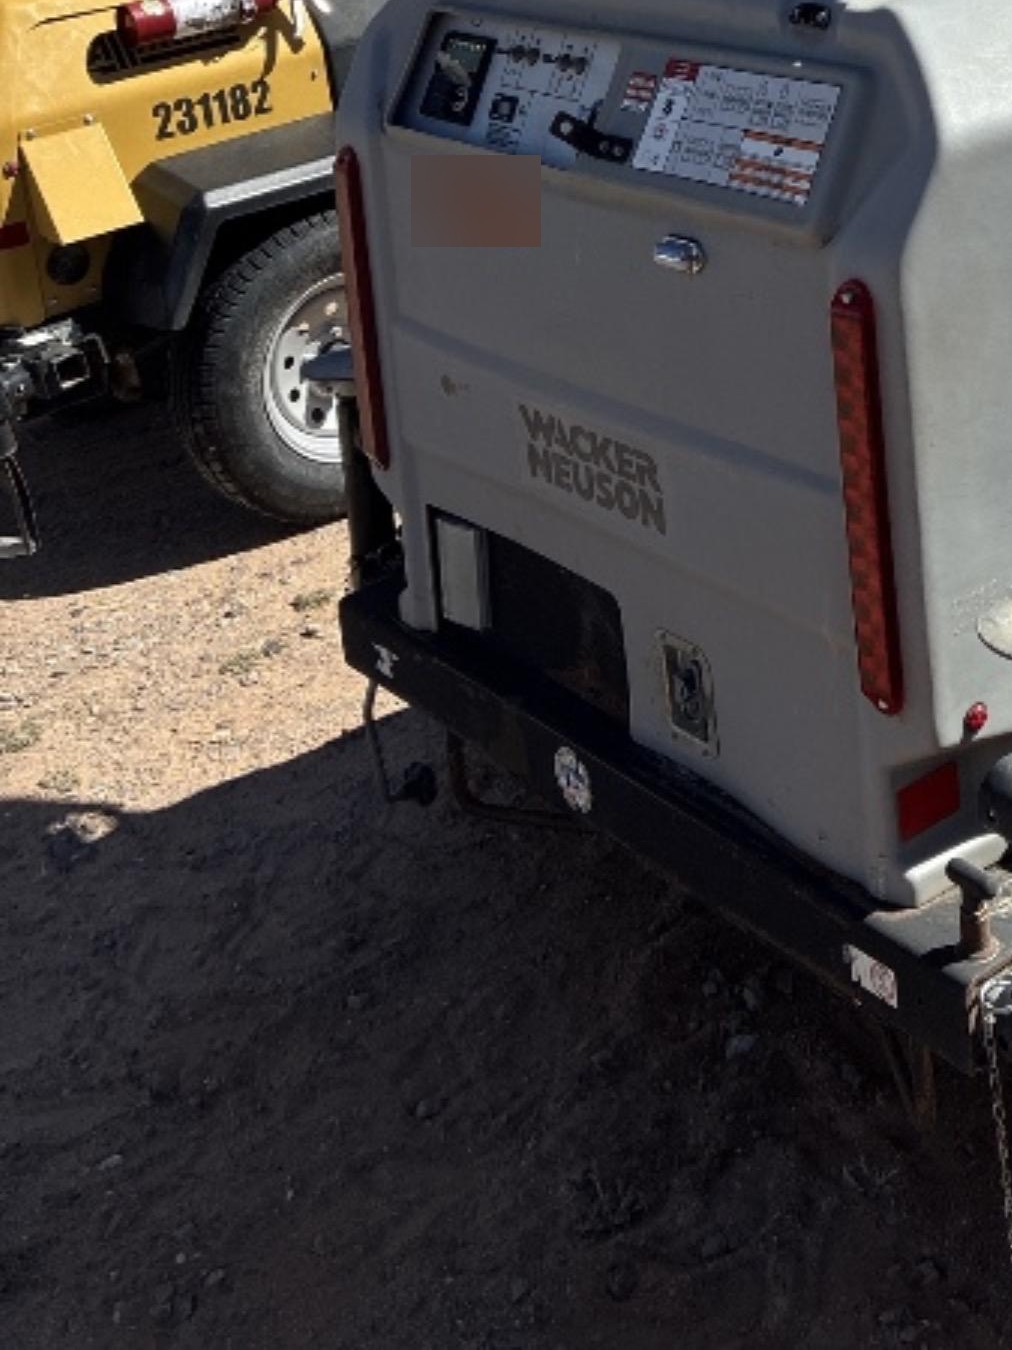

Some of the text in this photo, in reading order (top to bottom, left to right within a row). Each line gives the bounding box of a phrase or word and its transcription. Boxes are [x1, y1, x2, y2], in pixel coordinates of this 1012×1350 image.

[151, 79, 273, 142] 231182
[518, 403, 663, 495] WACKER
[527, 441, 667, 536] NEUSON
